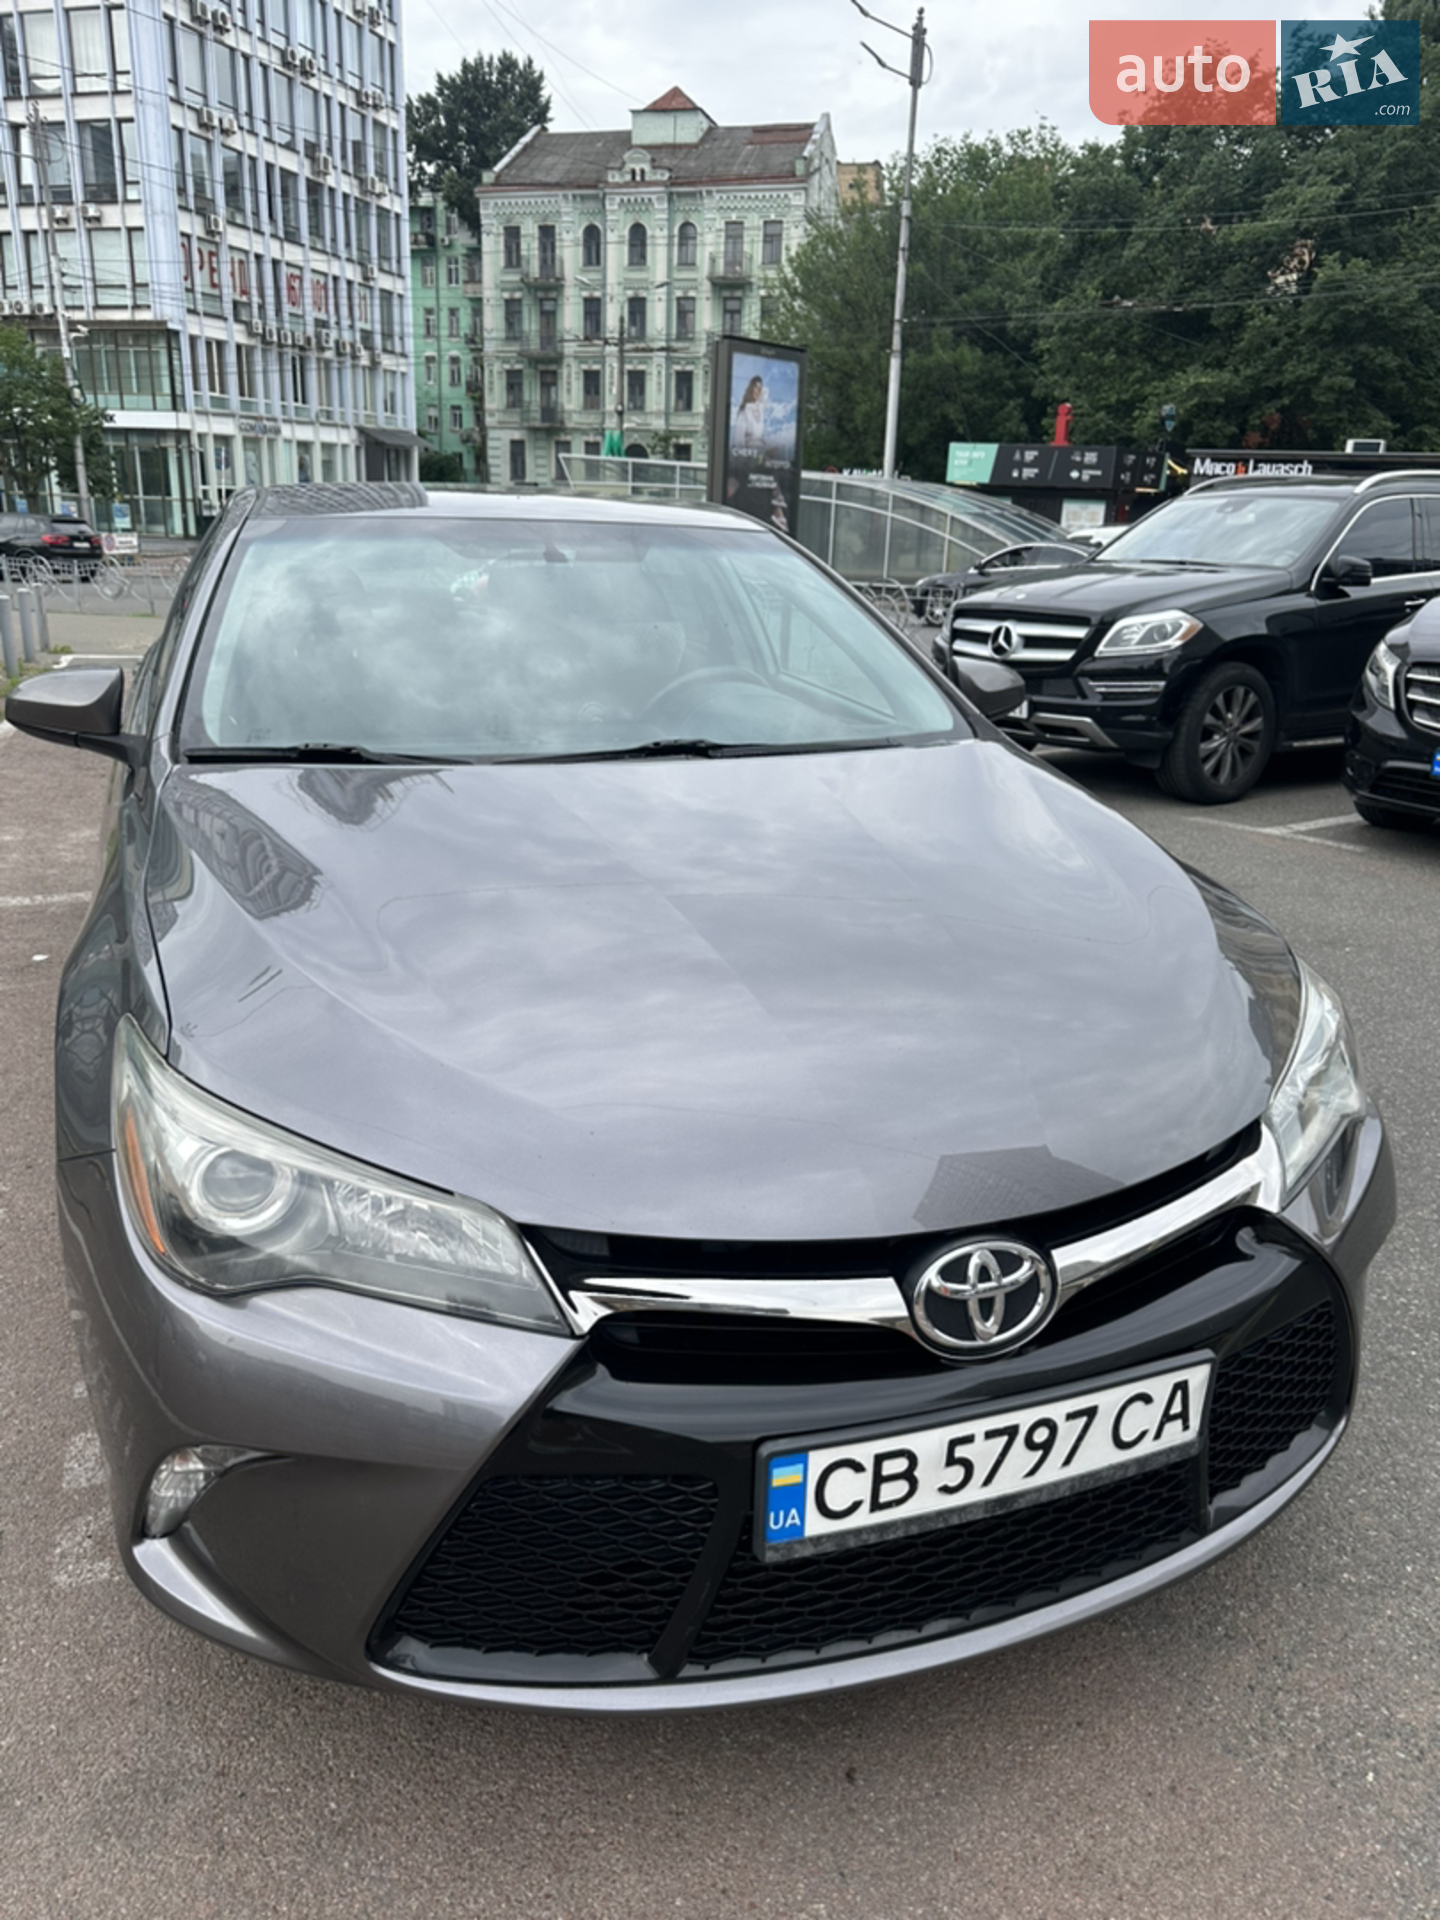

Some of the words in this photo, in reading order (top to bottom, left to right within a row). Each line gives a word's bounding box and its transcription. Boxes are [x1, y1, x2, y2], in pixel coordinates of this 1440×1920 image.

[814, 1449, 919, 1520] CB
[937, 1404, 1099, 1496] 5797
[1111, 1379, 1190, 1450] CA
[769, 1509, 801, 1531] UA
